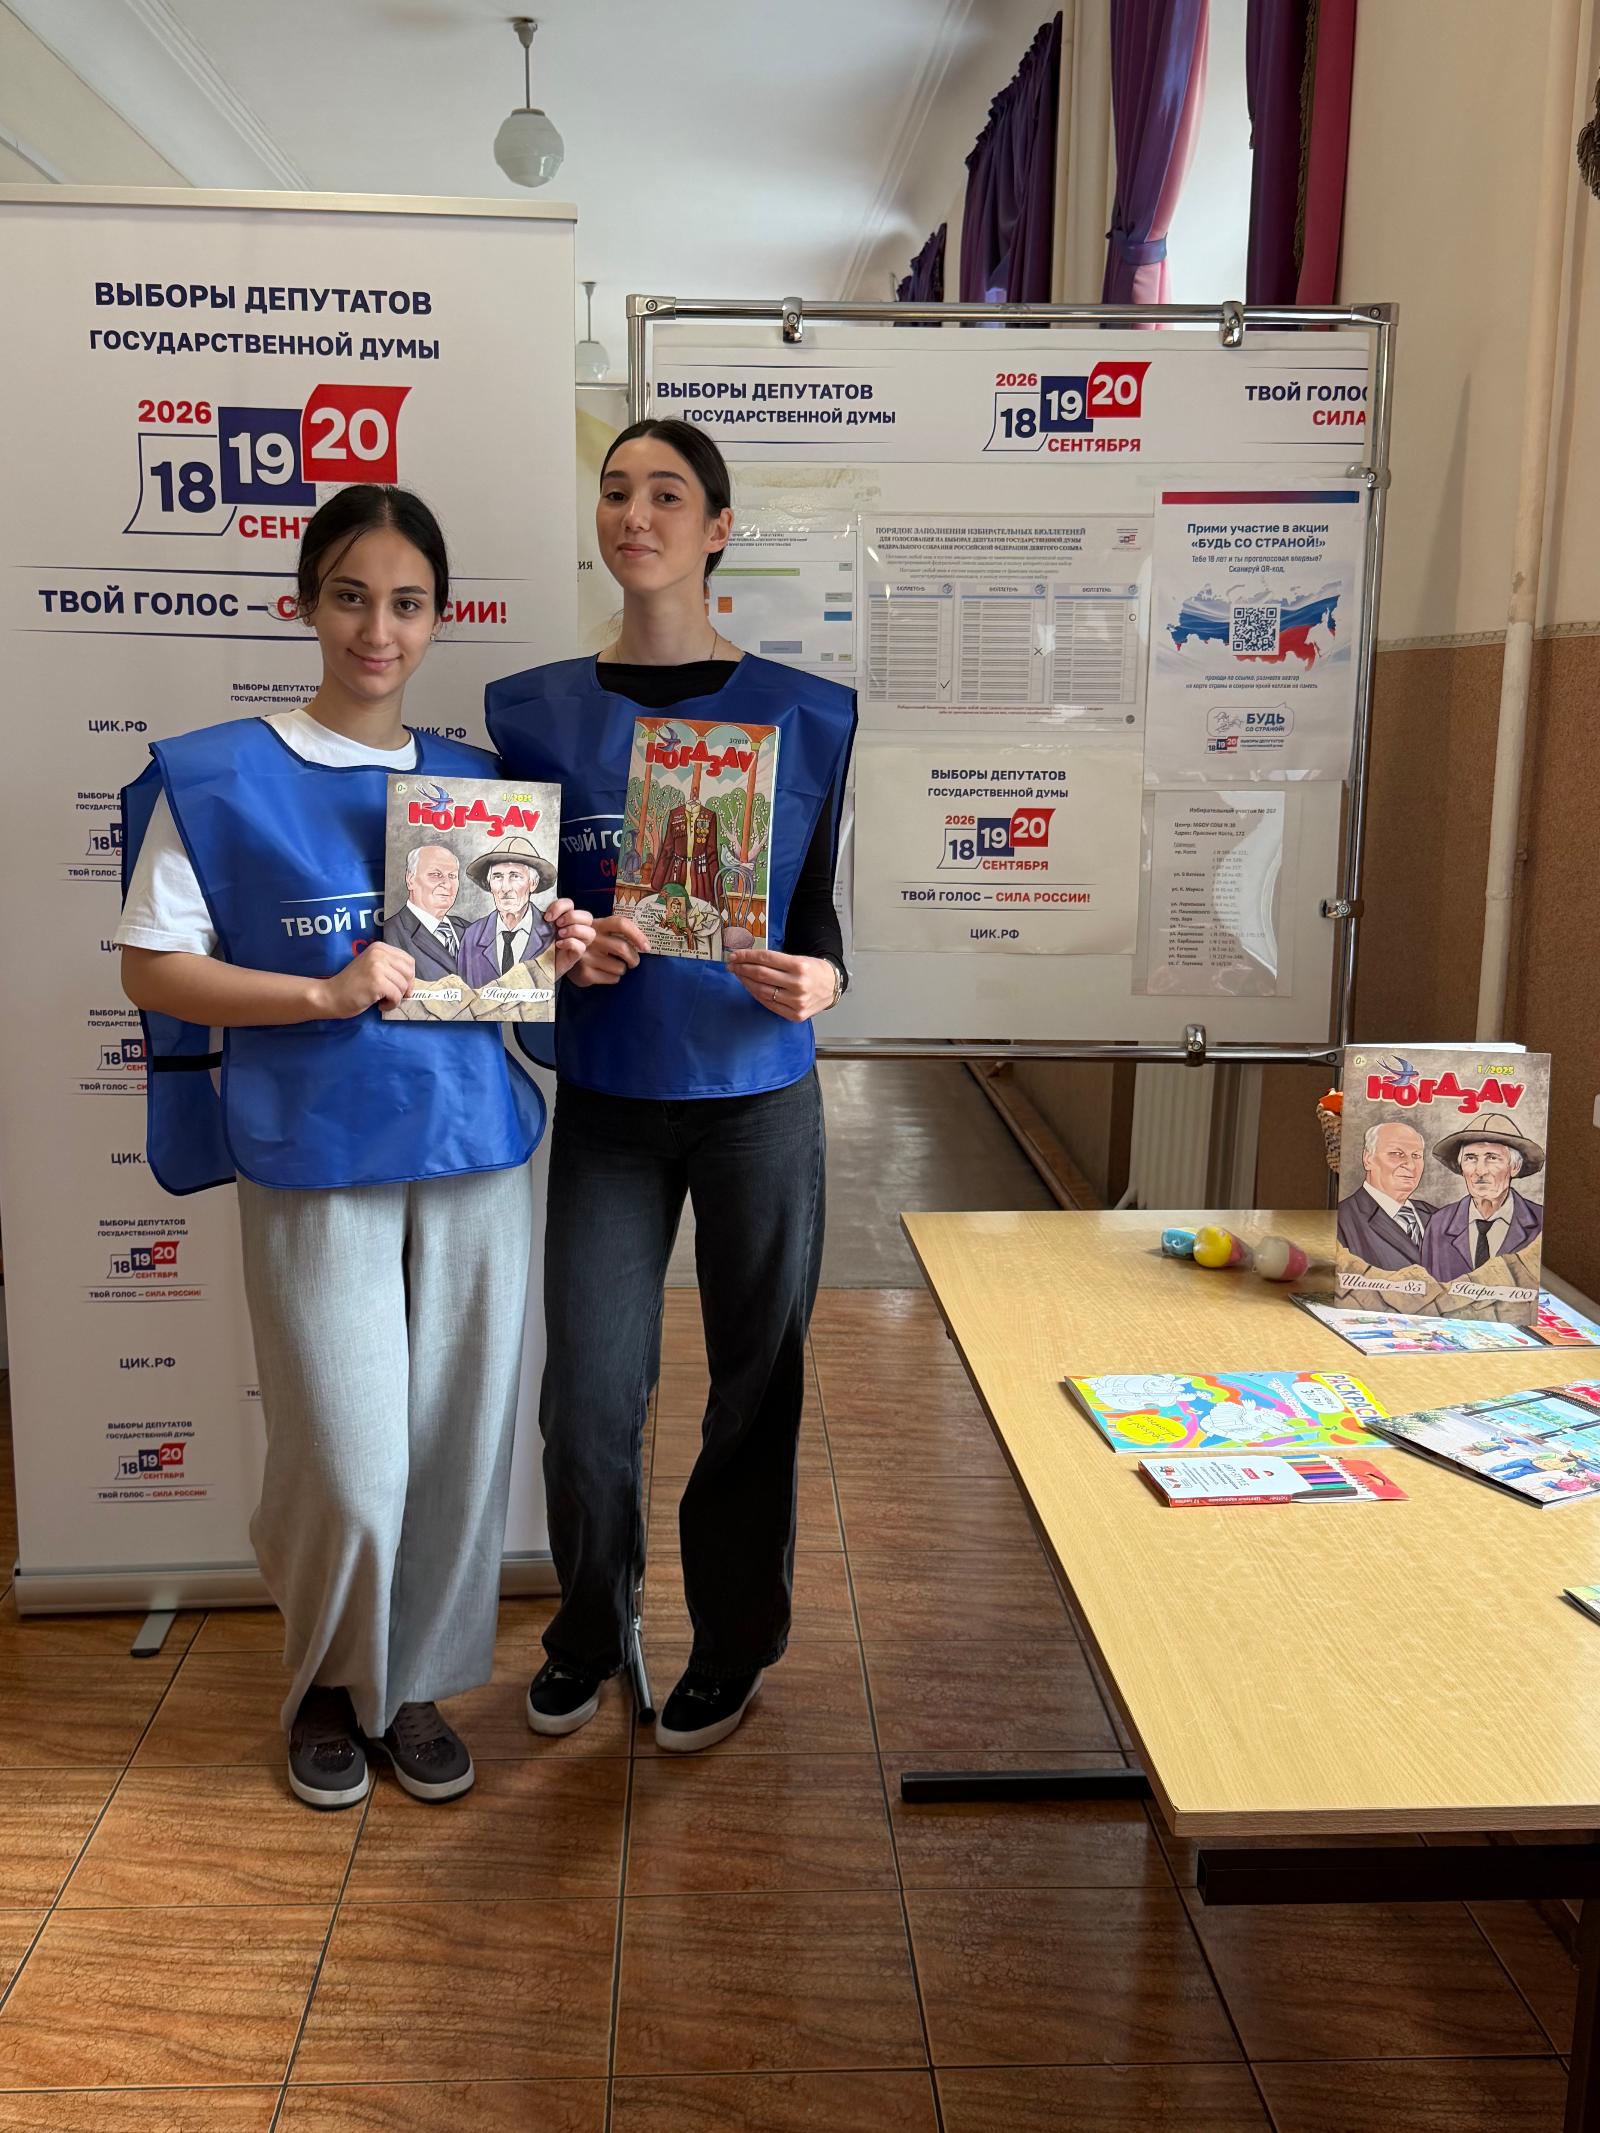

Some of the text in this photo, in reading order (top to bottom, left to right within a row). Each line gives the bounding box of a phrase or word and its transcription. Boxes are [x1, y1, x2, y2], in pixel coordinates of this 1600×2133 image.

[95, 282, 432, 315] ВЫБОРЫ ДЕПУТАТОВ
[90, 330, 439, 360] ГОСУДАРСТВЕННОЙ ДУМЫ
[995, 373, 1037, 387] 2026
[657, 382, 873, 401] ВЫБОРЫ ДЕПУТАТОВ
[1245, 382, 1300, 401] ТВОЙ
[138, 400, 212, 424] 2026
[1000, 374, 1138, 438] 18 19 20
[683, 408, 896, 425] ГОСУДАРСТВЕННОЙ ДУМЫ
[1312, 410, 1366, 425] СИЛА
[1048, 438, 1141, 452] СЕНТЯБРЯ
[151, 407, 389, 513] 18 19 20
[1187, 523, 1329, 536] Прими участие в акции
[1191, 536, 1326, 550] «БУДЬ СО СТРАНОЙ!»
[39, 585, 124, 616] ТВОЙ
[135, 592, 239, 617] ГОЛОС
[233, 683, 270, 692] ВЫБОРЫ
[231, 695, 301, 703] ГОСУДАРСТВЕННОЙ
[1246, 713, 1285, 725] БУДЬ
[89, 720, 147, 736] ЦИК.РФ
[931, 769, 1066, 781] ВЫБОРЫ ДЕПУТАТОВ
[77, 792, 115, 800] ВЫБОРЫ
[928, 788, 1068, 798] ГОСУДАРСТВЕННОЙ ДУМЫ
[945, 815, 975, 825] 2026
[93, 836, 110, 850] 18
[949, 817, 1046, 861] 18 19 20
[68, 868, 117, 877] ТВОЙ ГОЛОС
[982, 860, 1049, 871] СЕНТЯБРЯ
[901, 888, 936, 901] ТВОЙ
[939, 891, 981, 902] ГОЛОС
[995, 892, 1030, 902] СИЛА
[1034, 892, 1091, 903] РОССИИ!
[281, 908, 351, 937] ТВОЙ
[970, 928, 1020, 940] ЦИК.РФ
[89, 1009, 126, 1017] ВЫБОРЫ
[104, 1044, 142, 1065] 18 19
[99, 1218, 186, 1227] ВЫБОРЫ ДЕПУТАТОВ
[113, 1246, 175, 1274] 18 19 20
[135, 1271, 178, 1279] СЕНТЯБРЯ
[1404, 1281, 1422, 1293] 85
[1509, 1290, 1533, 1299] 100
[119, 1357, 176, 1370] ЦИК.РФ
[108, 1421, 193, 1430] ВЫБОРЫ ДЕПУТАТОВ
[121, 1448, 182, 1475] 18 19 20
